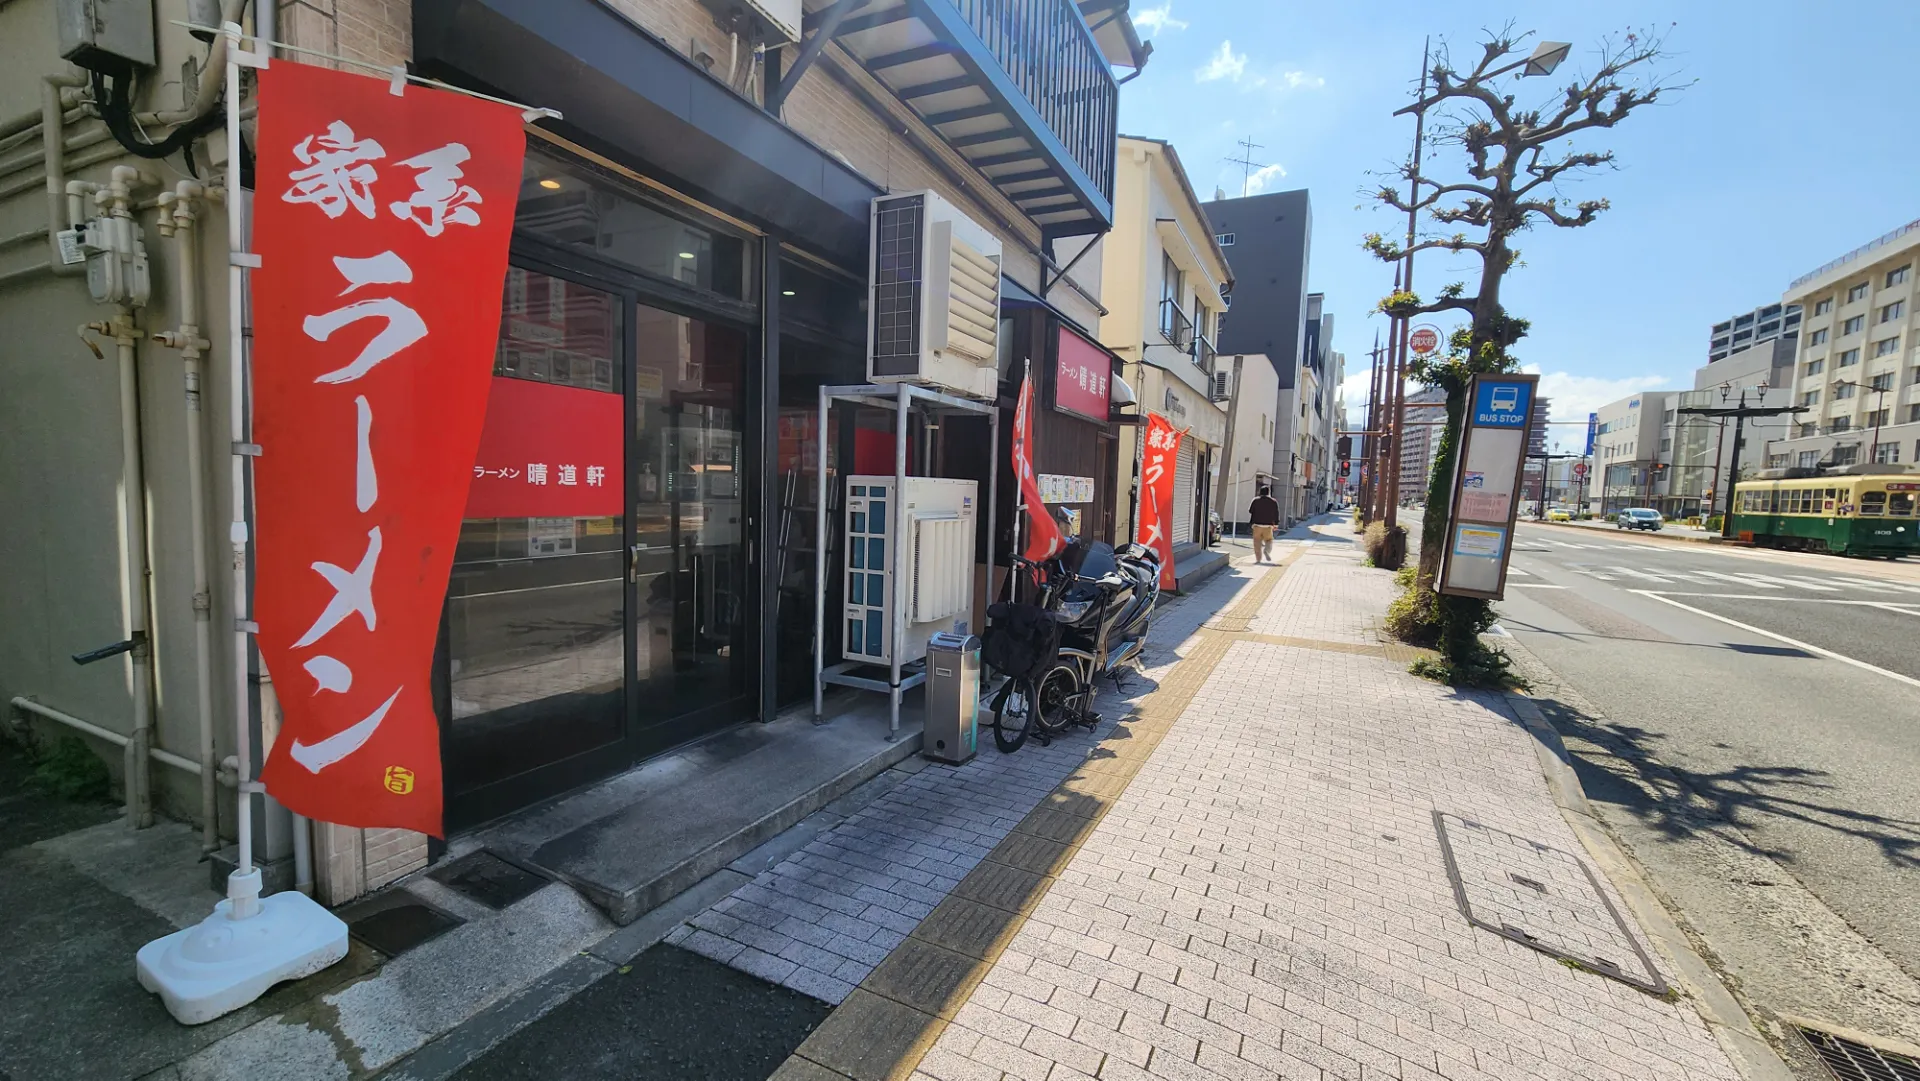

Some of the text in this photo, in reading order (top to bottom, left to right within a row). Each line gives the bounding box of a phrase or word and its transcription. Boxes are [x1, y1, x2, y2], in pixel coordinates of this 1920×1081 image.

[281, 119, 482, 237] 家系
[1411, 335, 1436, 347] 消火栓
[1061, 361, 1078, 379] ラーメン
[1479, 413, 1524, 423] BUS STOP
[1147, 425, 1176, 451] 家系
[473, 463, 605, 486] ラーメン 晴道軒
[289, 250, 428, 774] ラーメン
